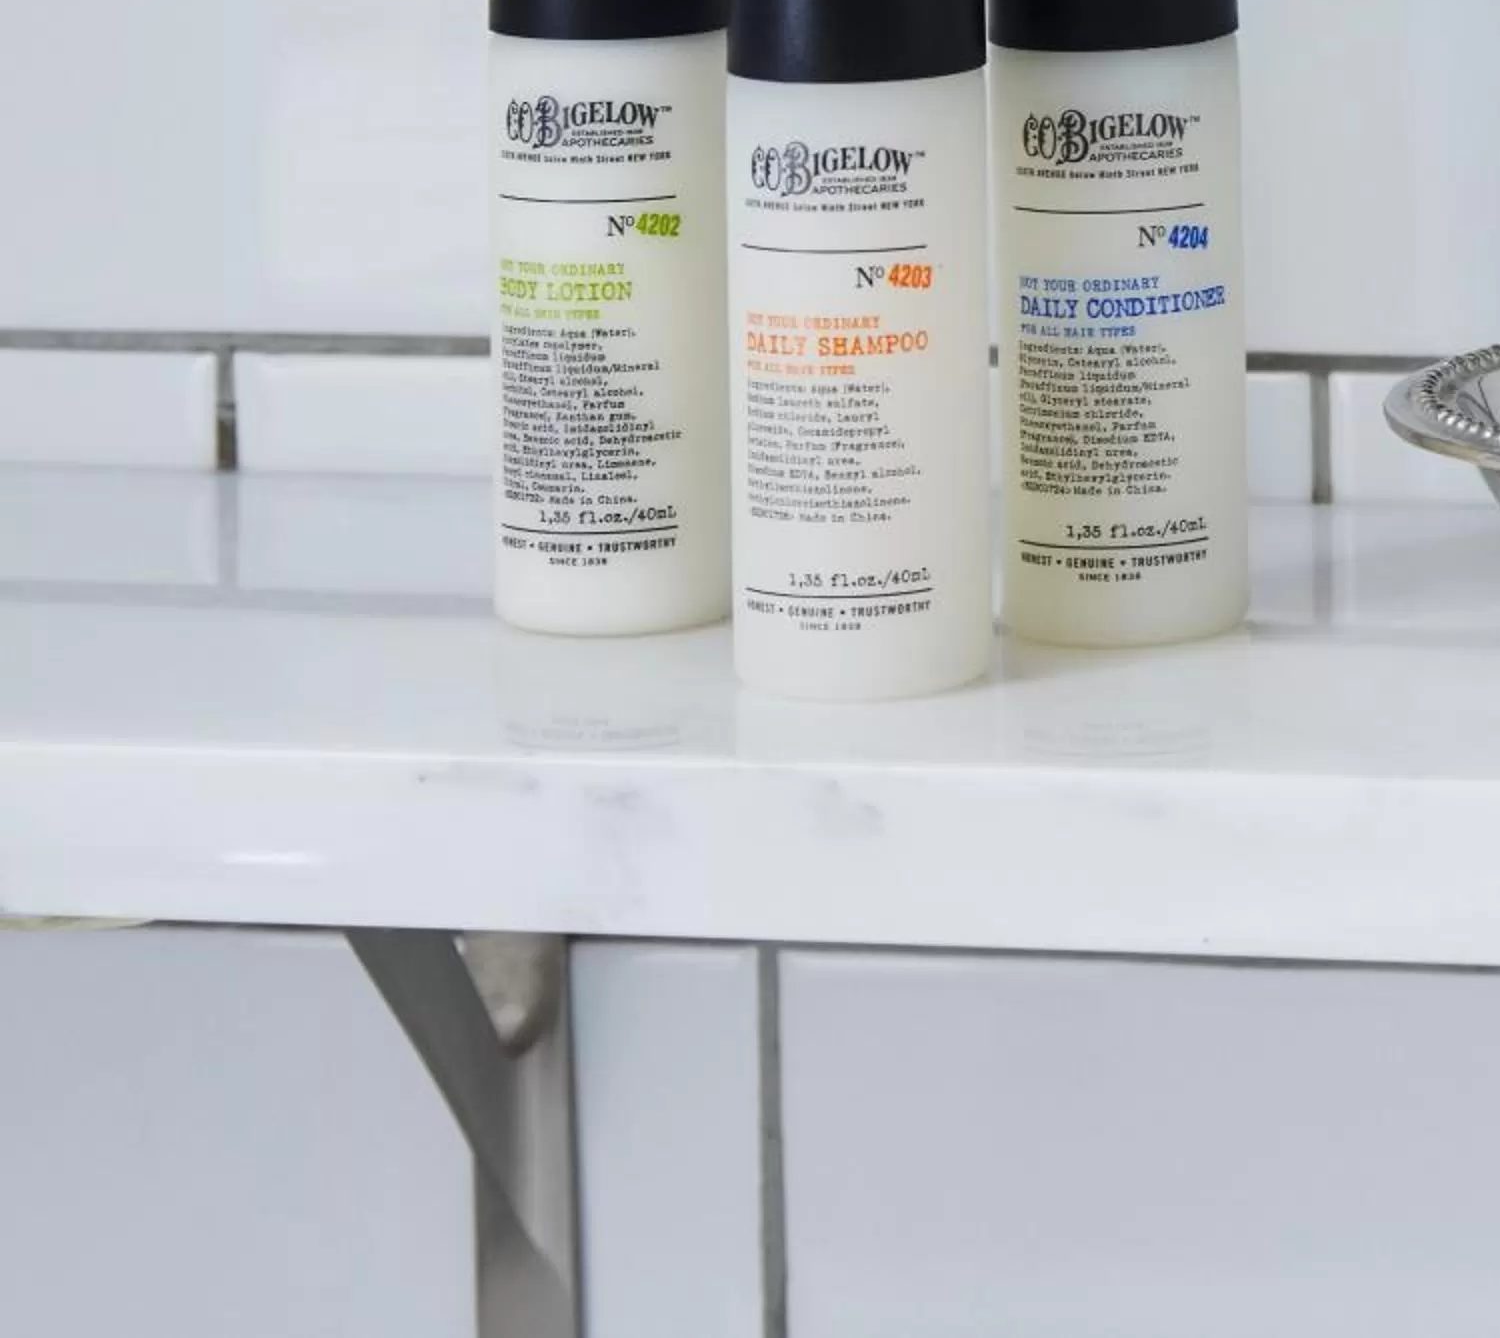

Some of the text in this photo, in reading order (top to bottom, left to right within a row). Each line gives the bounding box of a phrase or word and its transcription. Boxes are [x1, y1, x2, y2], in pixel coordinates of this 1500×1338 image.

[562, 136, 654, 147] APOTHECARIES
[1089, 148, 1183, 162] APOTHECARIES
[1158, 165, 1176, 176] NEW
[812, 182, 907, 195] APOTHECARIES
[636, 213, 680, 236] 4202
[1168, 225, 1208, 248] 4204
[888, 264, 932, 287] 4203
[547, 282, 632, 300] LOTION
[1044, 279, 1075, 292] YOUR
[1083, 277, 1160, 292] ORDINARY
[1020, 285, 1225, 318] DAILY CONDITIONER
[804, 316, 880, 329] ORDINARY
[1041, 326, 1060, 336] ALL
[1064, 327, 1094, 337] HAIR
[1100, 326, 1136, 337] TYPES
[748, 330, 929, 356] DAILY SHAMPOO
[538, 542, 581, 552] GENUINE
[599, 538, 676, 552] TRUSTWORTHY
[1066, 558, 1114, 568] GENUINE
[1131, 549, 1207, 567] TRUSTWORTHY
[788, 605, 833, 618] GENUINE
[851, 600, 931, 617] TRUSTWORTHY
